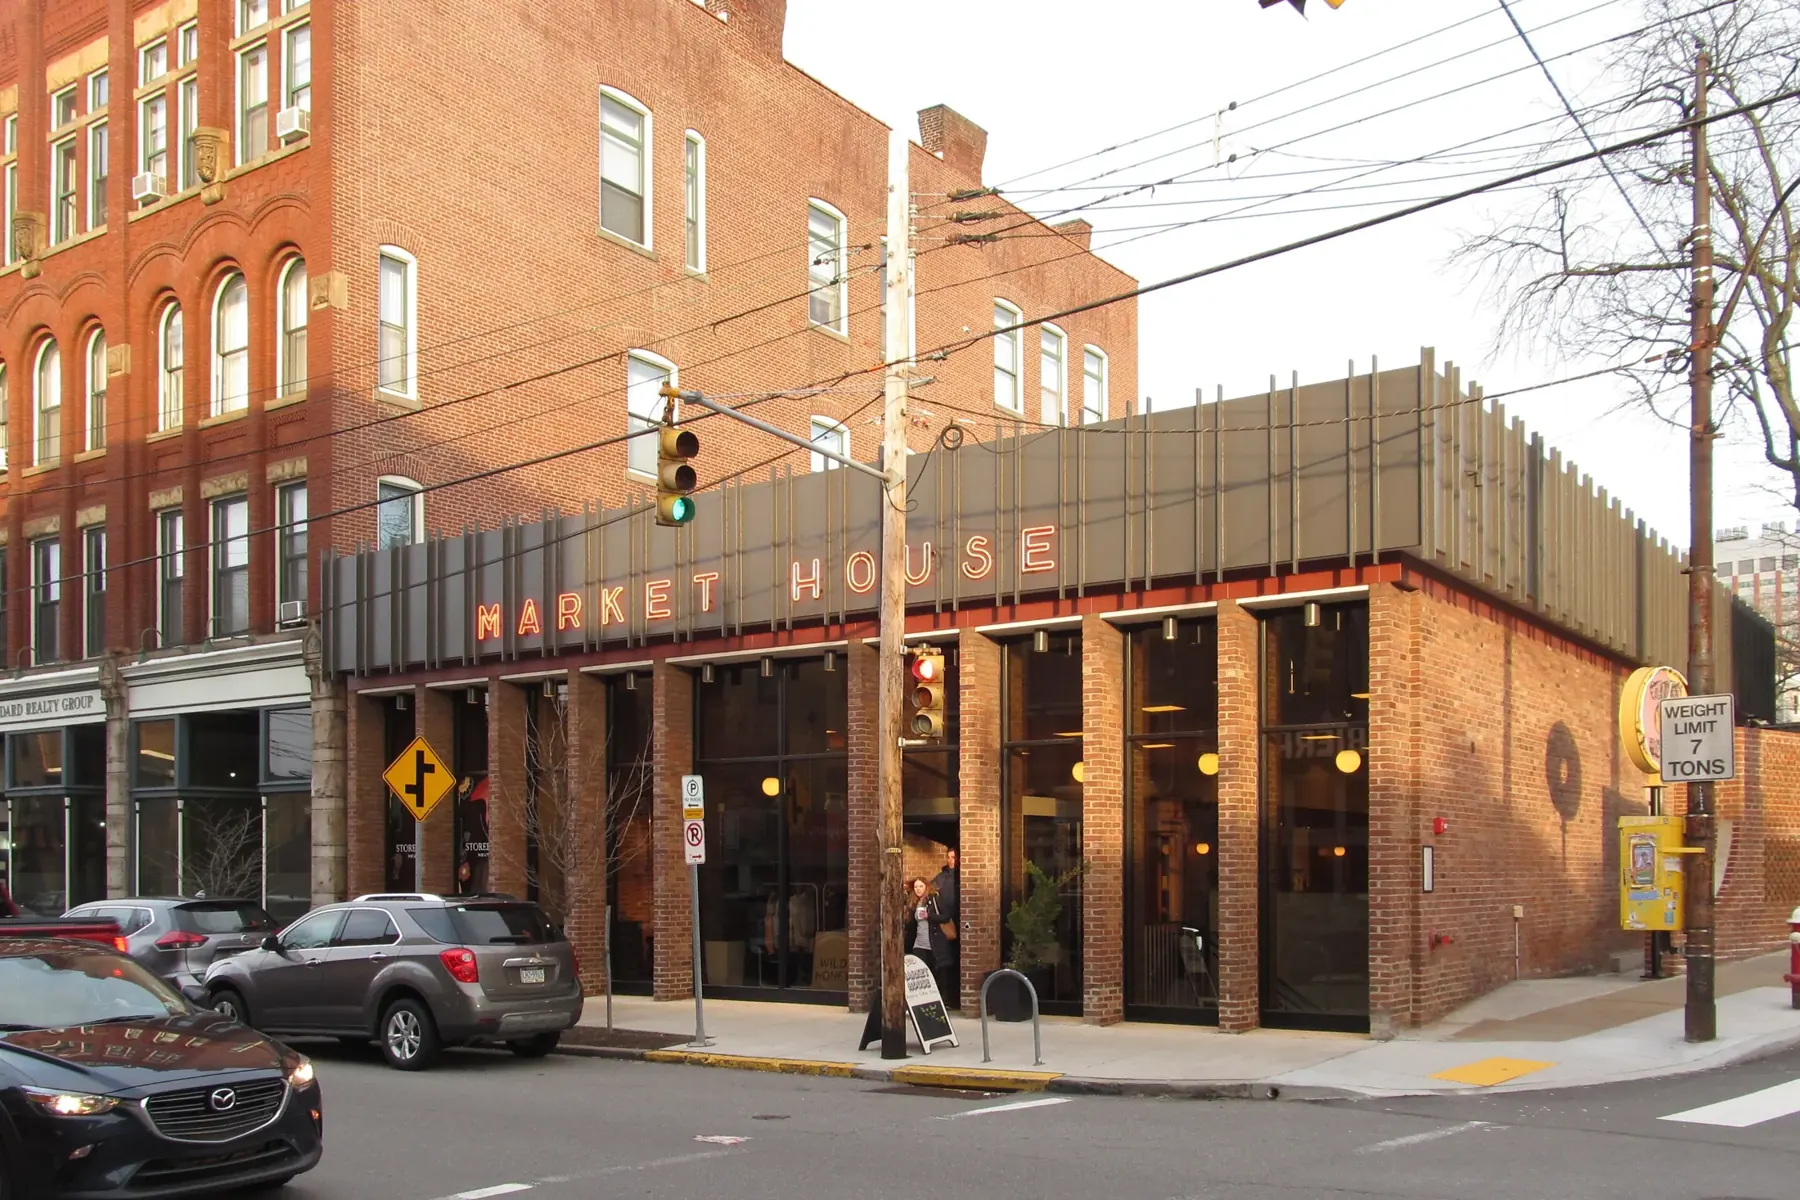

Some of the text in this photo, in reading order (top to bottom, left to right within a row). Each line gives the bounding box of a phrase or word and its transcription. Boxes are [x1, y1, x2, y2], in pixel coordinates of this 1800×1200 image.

[477, 525, 1056, 641] MARKET HOUSE
[26, 699, 60, 715] REALTY
[62, 695, 94, 711] GROUP
[1665, 703, 1727, 719] WEIGHT
[1674, 720, 1718, 735] LIMIT
[1690, 739, 1703, 755] 7
[1668, 759, 1726, 777] TONS
[820, 957, 848, 969] WILD
